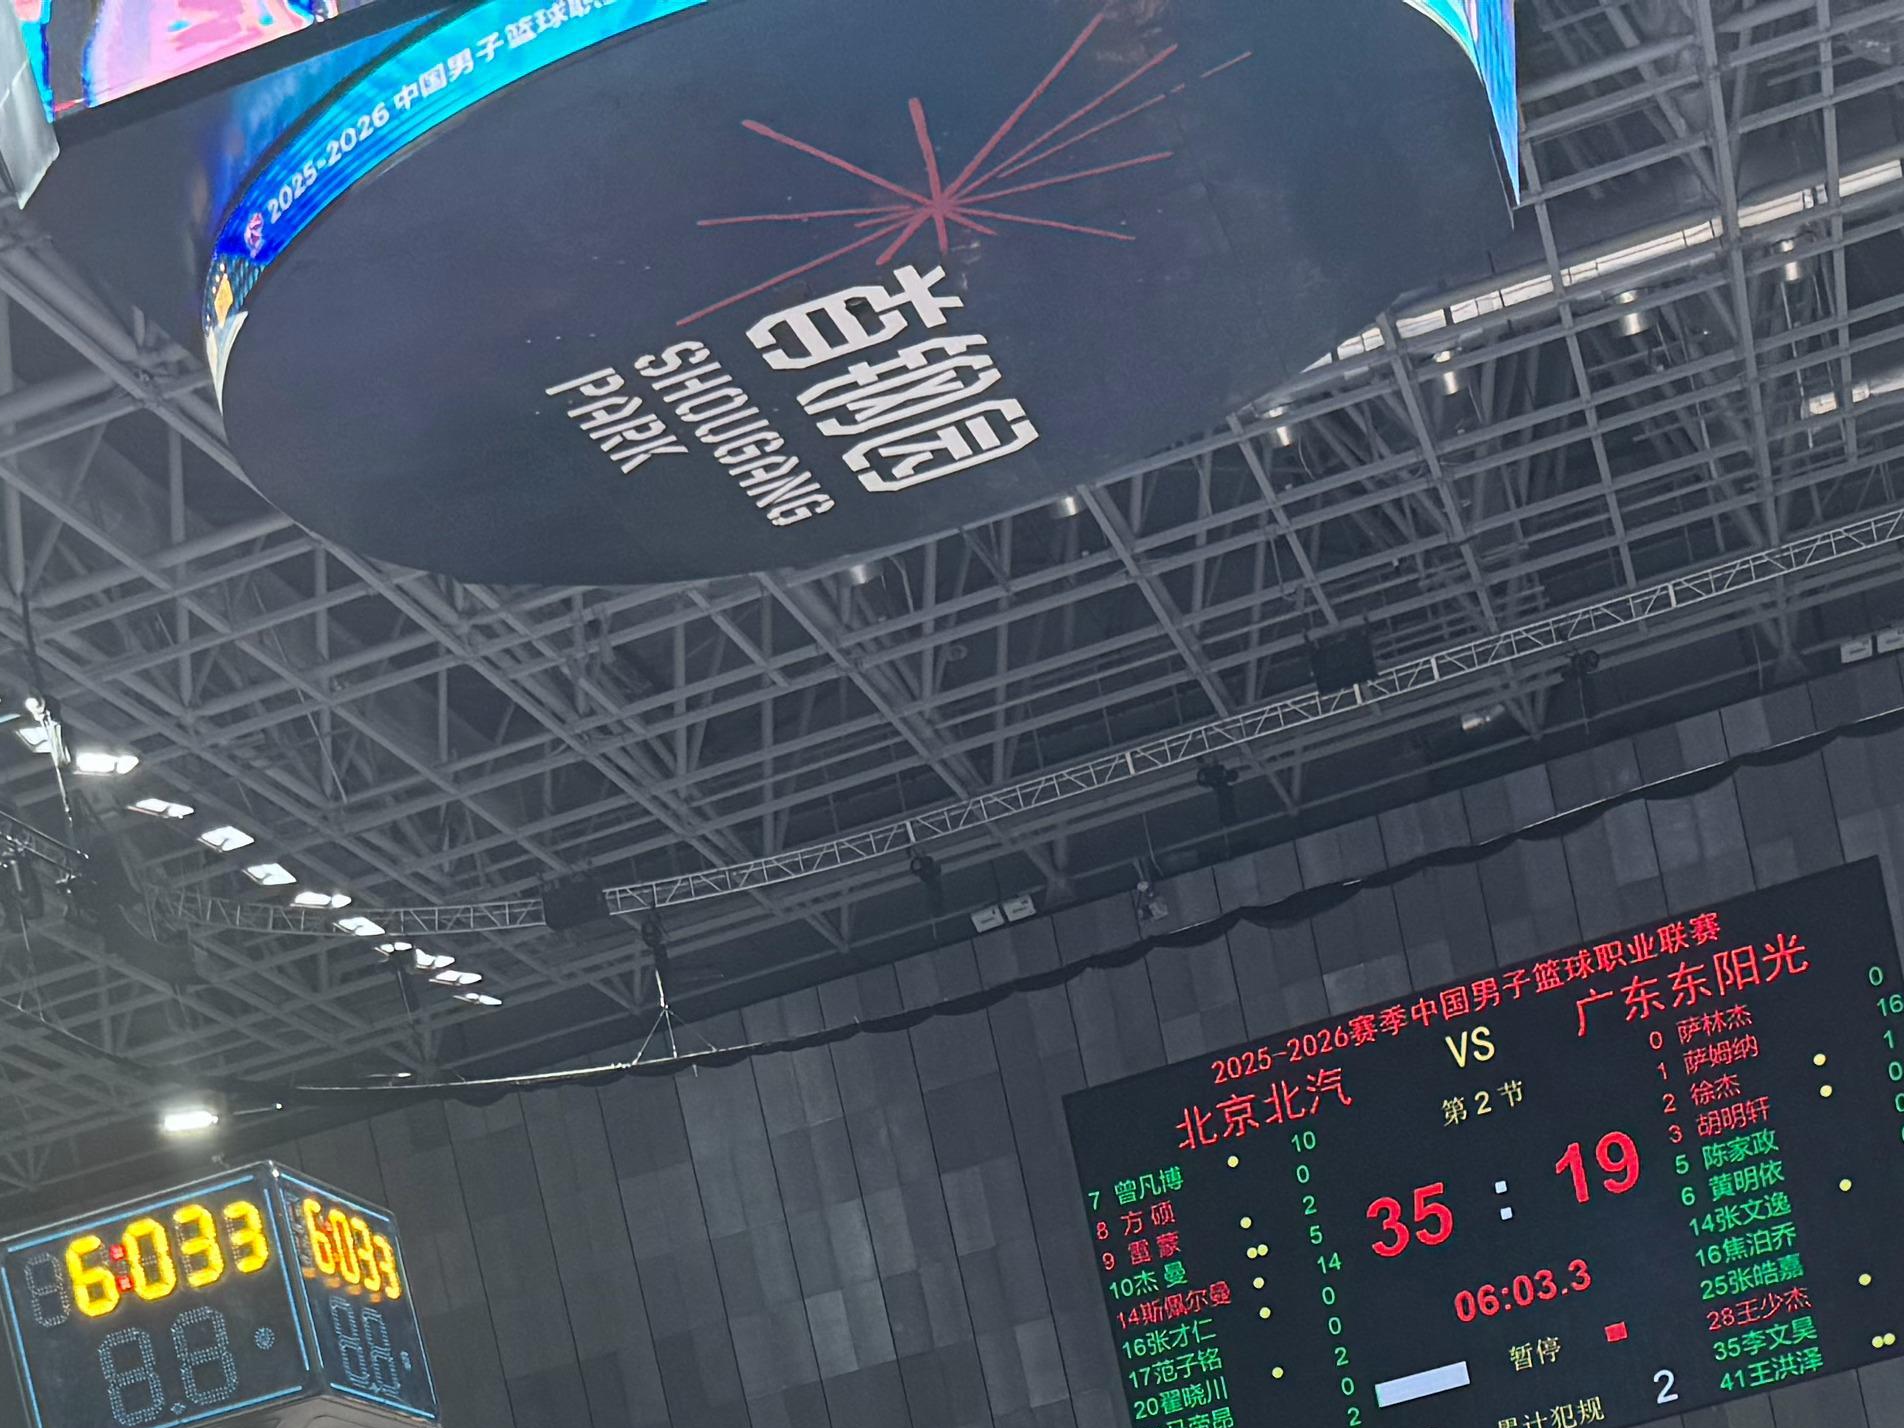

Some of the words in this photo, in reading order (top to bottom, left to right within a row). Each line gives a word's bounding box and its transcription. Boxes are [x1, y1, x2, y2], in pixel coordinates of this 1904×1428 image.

[267, 107, 391, 223] 2025-2026
[746, 265, 1039, 491] 首钢园
[546, 367, 688, 473] PARK
[634, 341, 835, 527] SHOUGANG
[1576, 932, 1810, 1039] 广东东阳光
[1868, 965, 1883, 986] 0
[1211, 912, 1721, 1085] 2025-2026赛季中国男子篮球职业联赛
[1876, 993, 1904, 1016] 16
[1650, 1030, 1663, 1049] 0
[1676, 1003, 1753, 1044] 萨林杰
[1883, 1030, 1894, 1049] 1
[1445, 1026, 1495, 1069] VS
[1657, 1061, 1667, 1080] 1
[1682, 1033, 1759, 1076] 萨姆纳
[1888, 1061, 1903, 1081] 0
[1176, 1068, 1352, 1149] 北京北汽
[1663, 1093, 1676, 1113] 2
[1690, 1072, 1741, 1106] 徐杰
[1668, 1124, 1683, 1144] 3
[1696, 1095, 1771, 1137] 胡明轩
[1291, 1131, 1316, 1152] 10
[1675, 1154, 1689, 1174] 5
[1702, 1128, 1779, 1170] 陈家政
[1088, 1191, 1100, 1211] 7
[1114, 1166, 1184, 1206] 曾凡博
[1296, 1164, 1309, 1183] 0
[1302, 1195, 1317, 1215] 2
[1366, 1182, 1455, 1258] 35
[1555, 1131, 1640, 1203] 19
[1681, 1186, 1695, 1206] 6
[1096, 1221, 1109, 1240] 8
[1120, 1200, 1176, 1236] 方硕
[1309, 1225, 1323, 1244] 5
[1102, 1252, 1115, 1271] 9
[1317, 1252, 1342, 1275] 14
[1322, 1286, 1335, 1305] 0
[1454, 1258, 1592, 1323] 06:03.3
[1328, 1316, 1342, 1335] 0
[1334, 1346, 1349, 1366] 2
[1509, 1336, 1561, 1371] 暂停
[1341, 1376, 1355, 1396] 0
[1653, 1369, 1678, 1404] 2
[1347, 1407, 1362, 1427] 2
